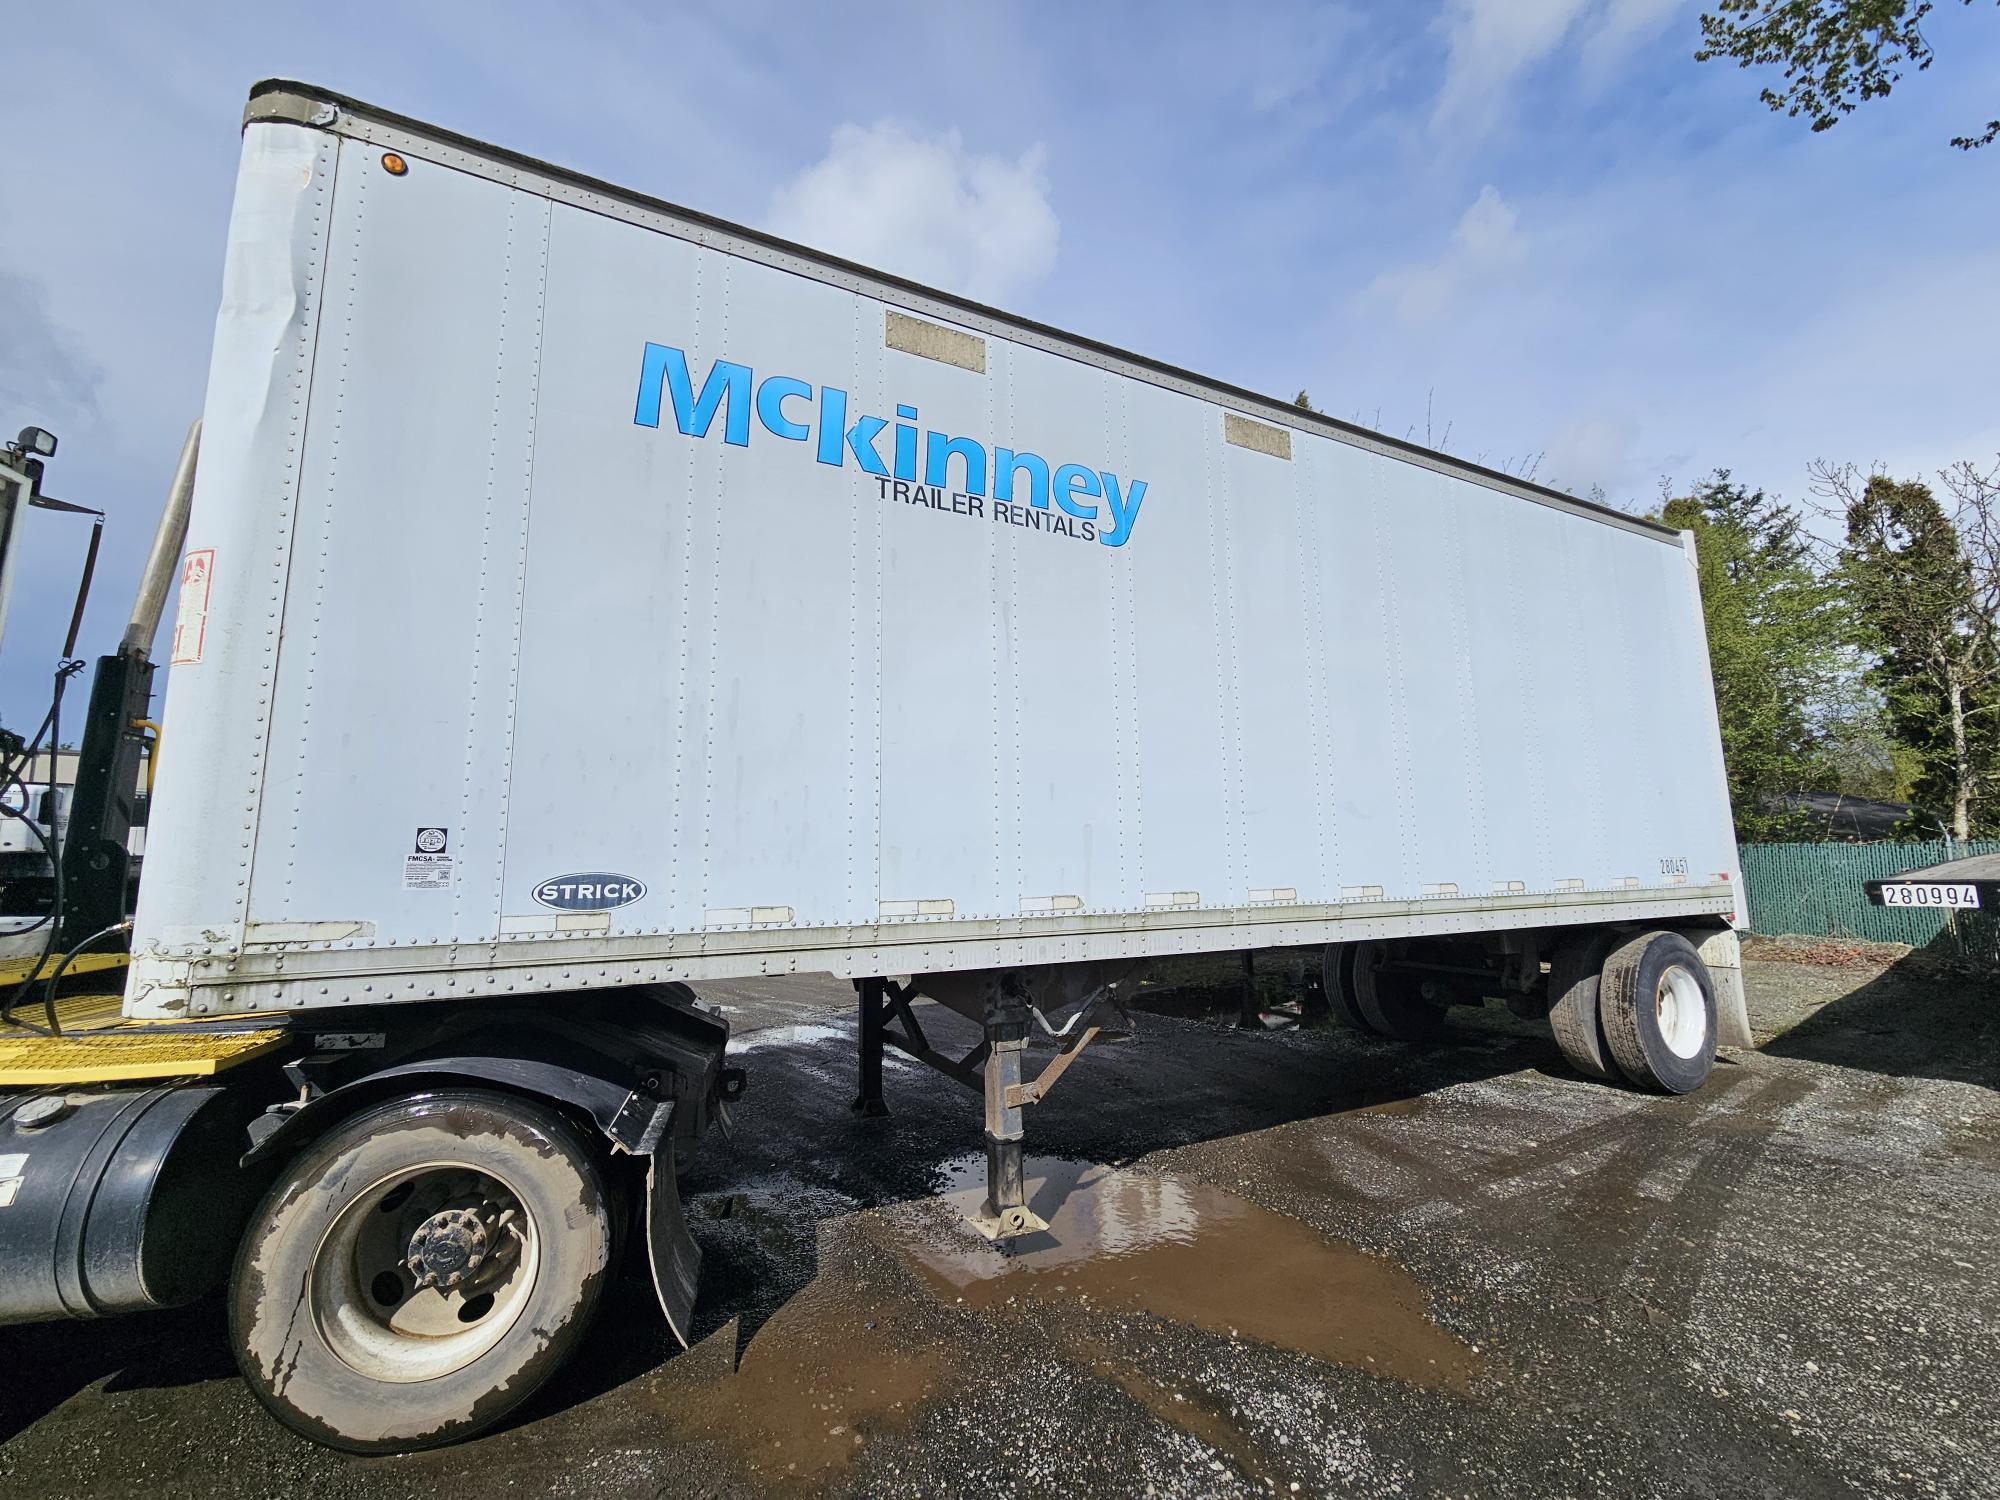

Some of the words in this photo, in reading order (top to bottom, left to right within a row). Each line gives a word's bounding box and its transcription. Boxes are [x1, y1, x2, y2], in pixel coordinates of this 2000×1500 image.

[874, 476, 985, 519] TRAILER
[993, 503, 1096, 542] RENTALS
[1660, 859, 1689, 874] 280451
[540, 883, 637, 900] STRICK
[1885, 887, 1976, 905] 280994
